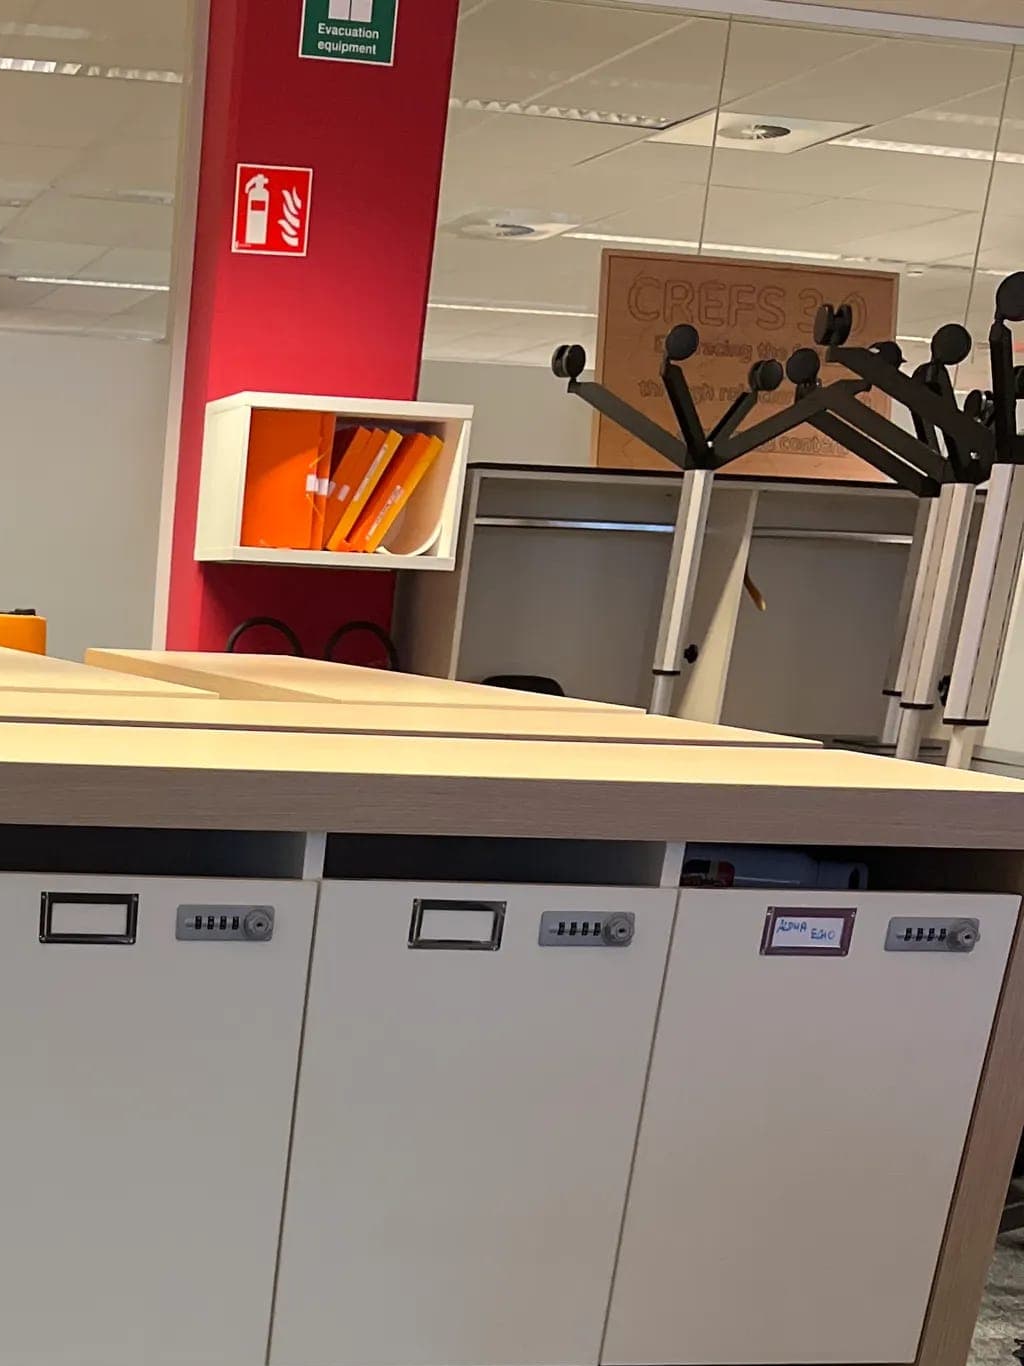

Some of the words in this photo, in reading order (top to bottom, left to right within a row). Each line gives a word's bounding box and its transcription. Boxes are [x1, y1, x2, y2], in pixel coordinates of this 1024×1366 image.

[318, 22, 379, 39] Evacuation
[317, 40, 377, 55] equipment
[628, 275, 787, 331] CREFS
